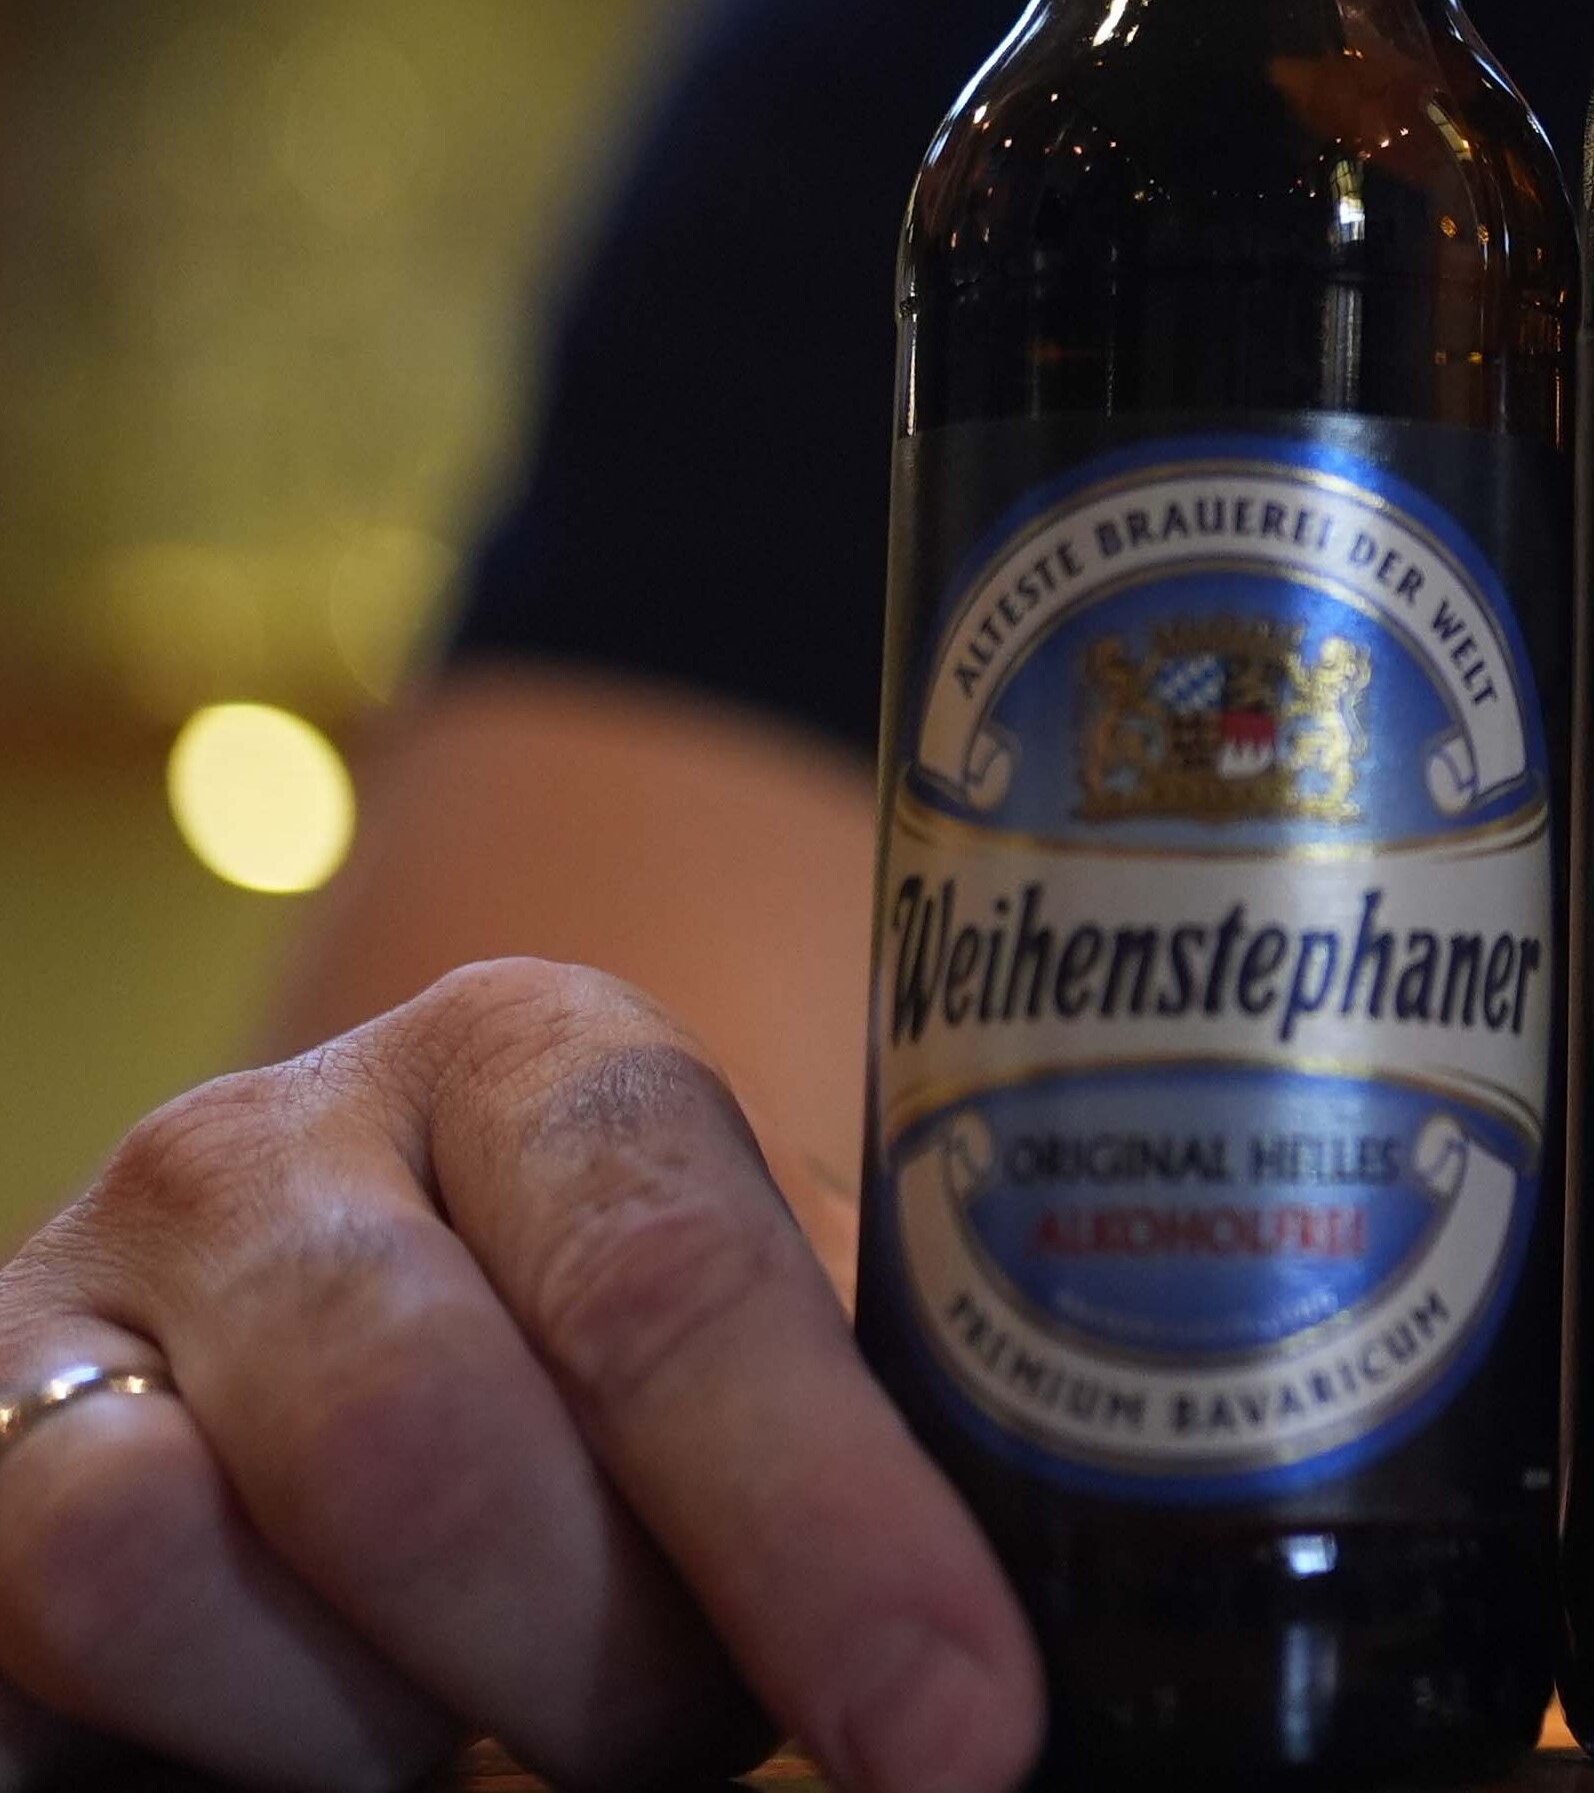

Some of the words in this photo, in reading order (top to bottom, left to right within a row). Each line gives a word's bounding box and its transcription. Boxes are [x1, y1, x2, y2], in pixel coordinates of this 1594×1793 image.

[1095, 496, 1330, 557] BRAUEREI
[1348, 532, 1424, 605] DER
[1429, 598, 1501, 707] WELT
[891, 874, 1541, 1048] Weihenstephaner
[1005, 1135, 1232, 1186] ORIGINAL
[947, 1294, 1148, 1429] PREMIUM
[1175, 1293, 1453, 1436] BAVARICUM
